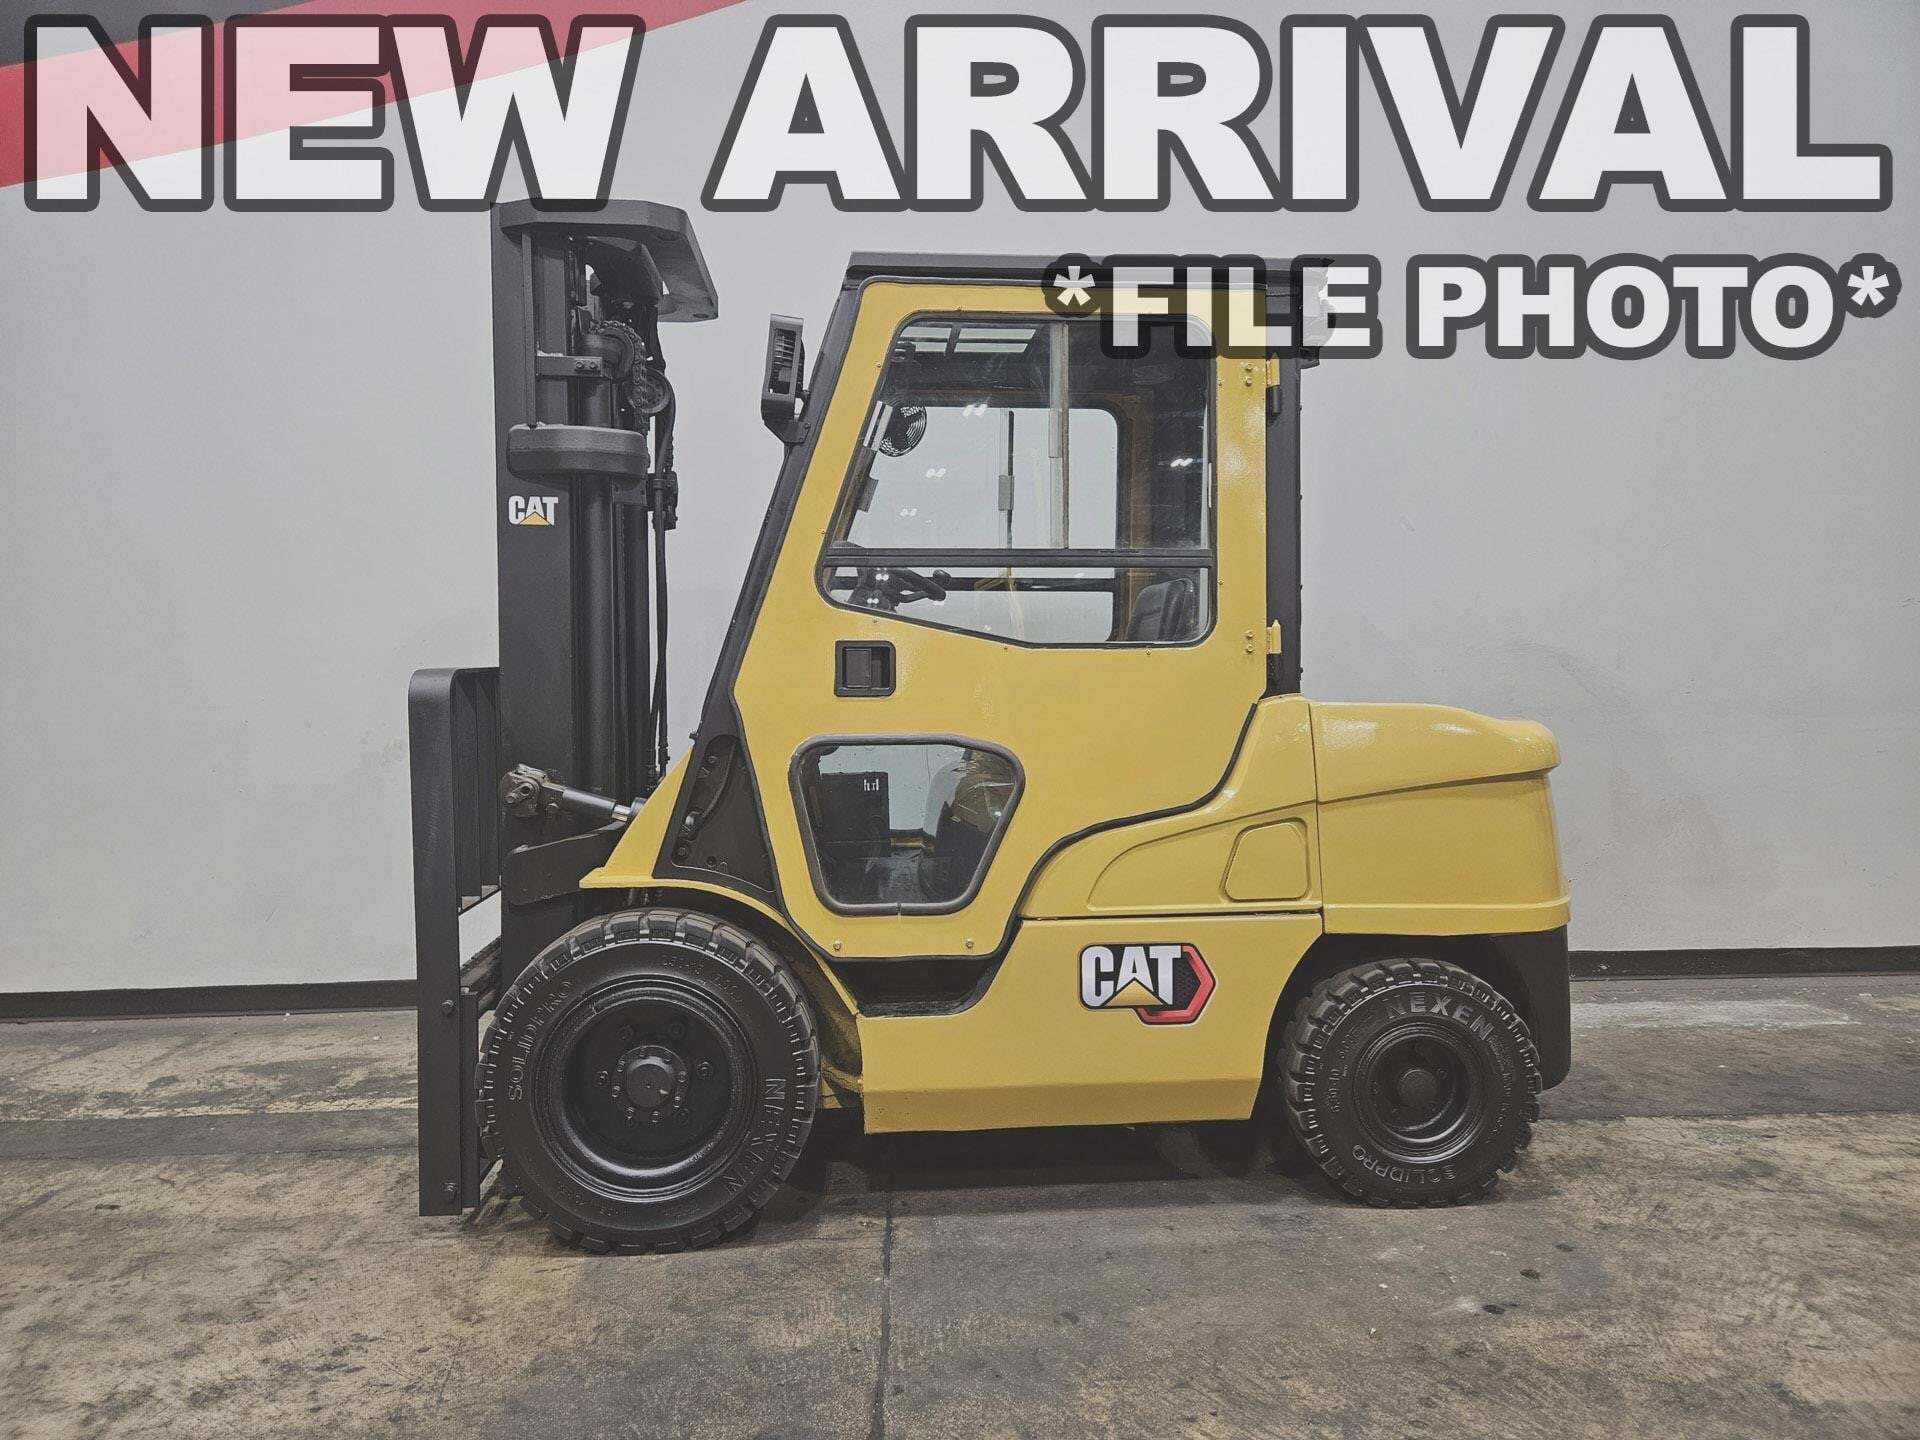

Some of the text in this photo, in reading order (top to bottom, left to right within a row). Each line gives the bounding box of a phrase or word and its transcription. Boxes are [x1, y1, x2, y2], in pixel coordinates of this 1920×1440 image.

[508, 495, 559, 525] CAT
[1080, 945, 1182, 1007] CAT
[508, 981, 572, 1101] SOLIDPRO
[1385, 991, 1496, 1041] NEXEN
[1352, 1143, 1457, 1185] SOLIDPRO
